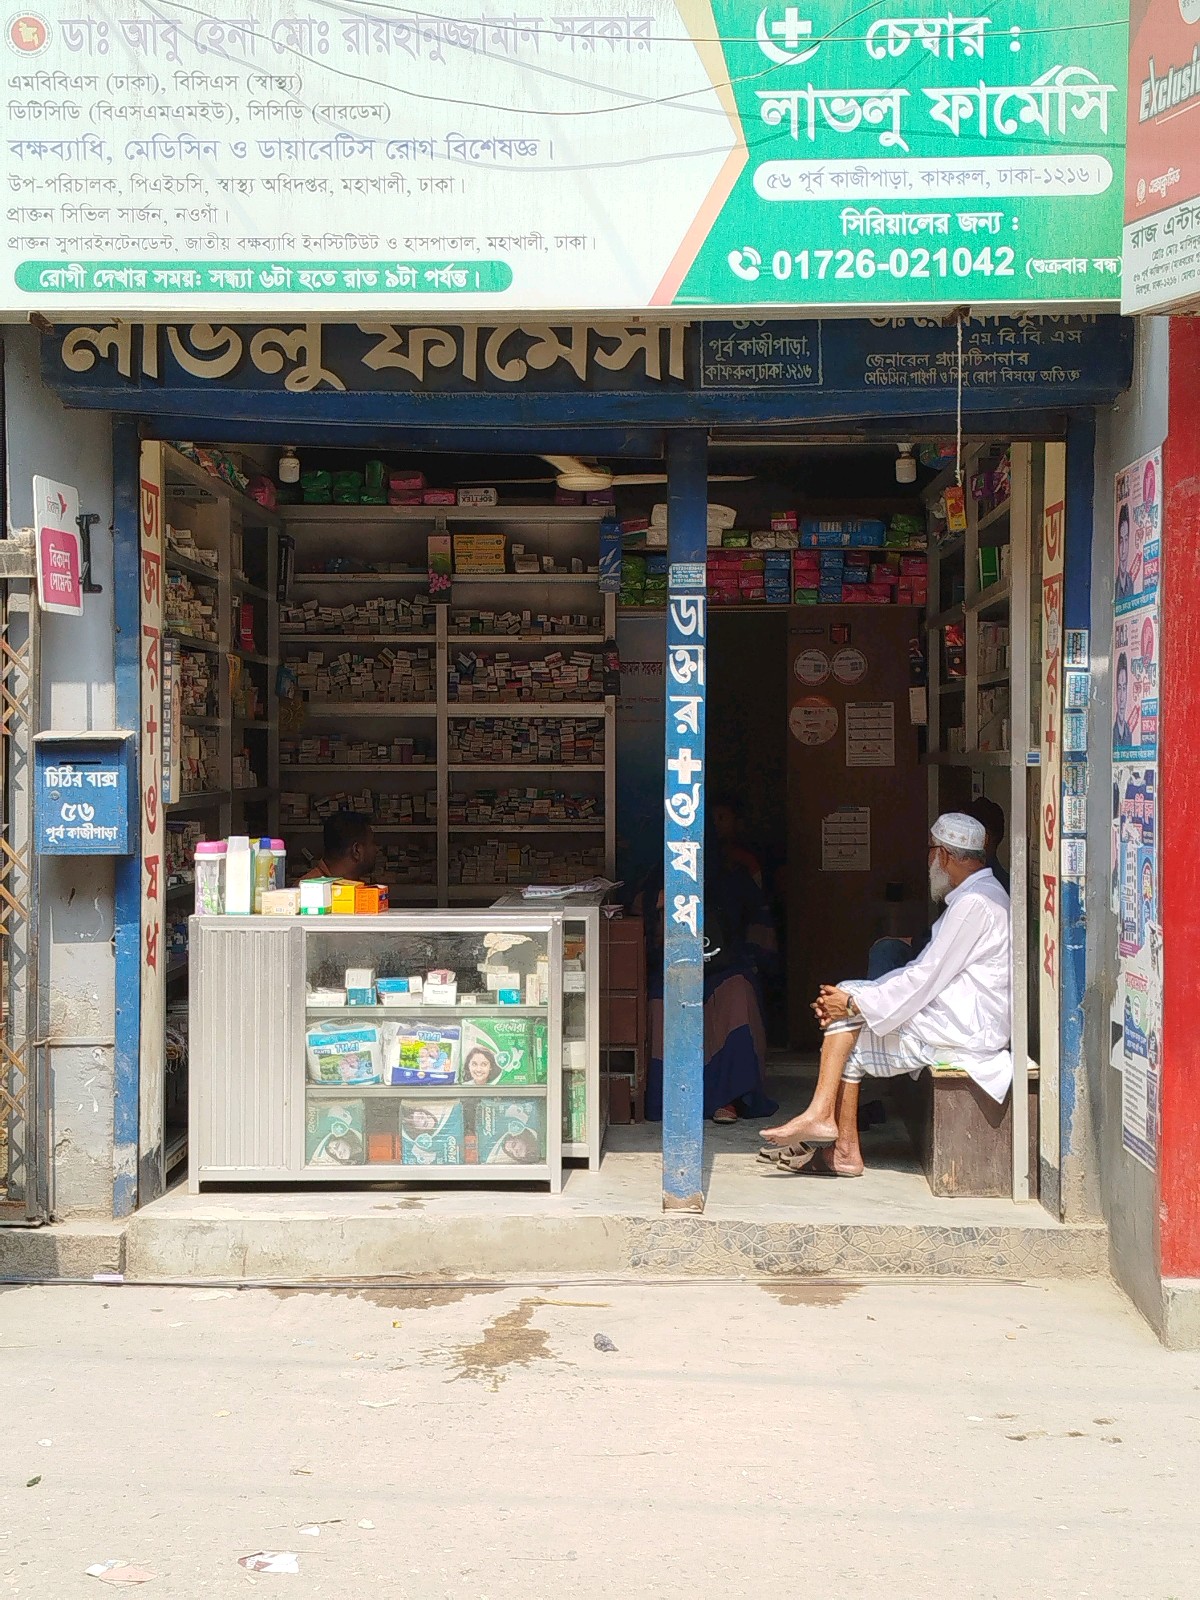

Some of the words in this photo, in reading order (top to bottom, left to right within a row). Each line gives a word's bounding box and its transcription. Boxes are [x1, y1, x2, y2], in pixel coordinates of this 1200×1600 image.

[59, 15, 109, 56] ডাঃ
[119, 15, 183, 66] আবু
[195, 14, 259, 60] হেনা
[271, 14, 330, 56] মোঃ
[340, 12, 545, 65] রায়হানুজ্জামান
[551, 11, 656, 54] সরকার
[865, 12, 992, 62] চেম্বার
[8, 71, 99, 91] এমবিবিএস
[106, 73, 166, 95] (ঢাকা),
[173, 71, 239, 91] বিসিএস
[247, 73, 303, 93] (স্বাস্থ্য)
[7, 99, 82, 121] ডিটিসিডি
[89, 99, 240, 124] (বিএসএমএমইউ),
[247, 100, 305, 121] সিসিডি
[312, 102, 391, 124] (বারডেম)
[754, 82, 911, 152] লাভলু
[921, 65, 1118, 138] ফার্মেসি
[8, 133, 112, 165] বক্ষব্যাধি,
[124, 132, 221, 161] মেডিসিন
[230, 140, 247, 160] ও
[257, 133, 376, 161] ডায়াবেটিস
[386, 136, 437, 161] রোগ
[8, 173, 122, 196] উপ-পরিচালক,
[130, 173, 209, 196] পিএইচসি,
[216, 176, 256, 197] স্বাস্থ্য
[261, 173, 334, 196] অধিদপ্তর,
[341, 172, 411, 197] মহাখালী,
[766, 171, 791, 188] ৫৬
[799, 169, 825, 194] পূর্ব
[830, 166, 913, 191] কাজীপাড়া,
[920, 169, 991, 190] কাফরুল,
[7, 206, 55, 224] প্রাক্তন
[61, 203, 111, 223] সিভিল
[117, 202, 168, 227] সার্জন,
[839, 207, 950, 237] সিরিয়ালের
[957, 212, 1004, 235] জন্য
[7, 234, 49, 251] প্রাক্তন
[55, 233, 179, 253] সুপারইনটেনডেন্ট,
[184, 232, 229, 251] জাতীয়
[236, 232, 297, 251] বক্ষব্যাধি
[302, 232, 380, 252] ইনস্টিটিউট
[387, 237, 397, 250] ও
[403, 235, 481, 253] হাসপাতাল,
[486, 231, 549, 253] মহাখালী,
[1130, 222, 1158, 249] রাজ
[39, 264, 88, 290] রোগী
[93, 268, 149, 290] দেখার
[208, 268, 254, 289] সন্ধ্যা
[259, 264, 293, 288] ৬টা
[298, 268, 338, 290] হতে
[342, 268, 380, 289] রাত
[385, 263, 418, 289] ৯টা
[772, 246, 1015, 281] 01726-021042
[1025, 257, 1087, 279] (শুক্রবার
[1093, 255, 1123, 277] বন্ধ)
[62, 323, 346, 392] লাভলু
[709, 333, 736, 361] পূর্ব
[866, 351, 931, 367] জেনারেল
[973, 371, 997, 384] রোগ
[1040, 366, 1081, 382] অভিজ্ঞ
[44, 765, 83, 787] চিঠির
[85, 771, 119, 788] বাক্স
[60, 802, 95, 821] ৫৬
[46, 825, 65, 844] পূর্ব
[66, 823, 118, 841] কাজীপাড়া
